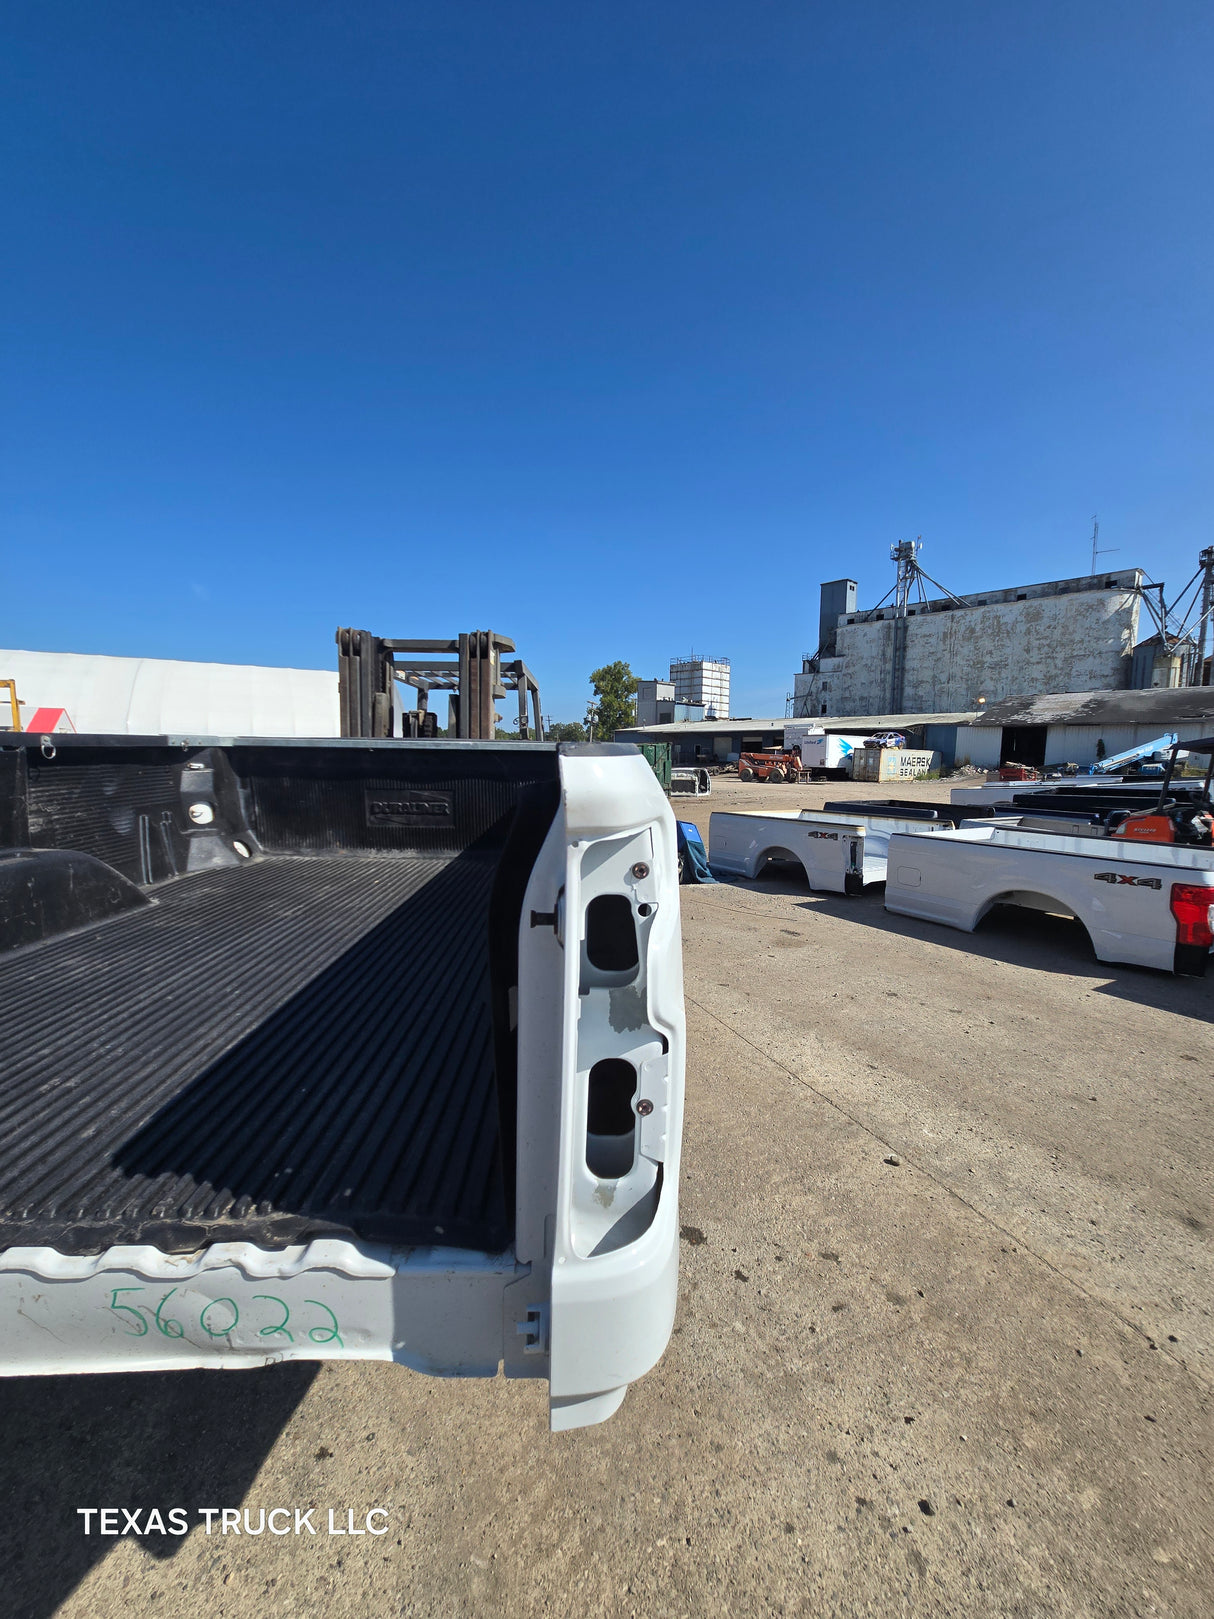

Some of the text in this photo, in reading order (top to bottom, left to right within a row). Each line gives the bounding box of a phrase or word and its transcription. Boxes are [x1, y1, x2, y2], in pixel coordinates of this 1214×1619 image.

[900, 756, 931, 767] MAERSK
[900, 768, 927, 777] SEALAN
[111, 1287, 344, 1348] 56022
